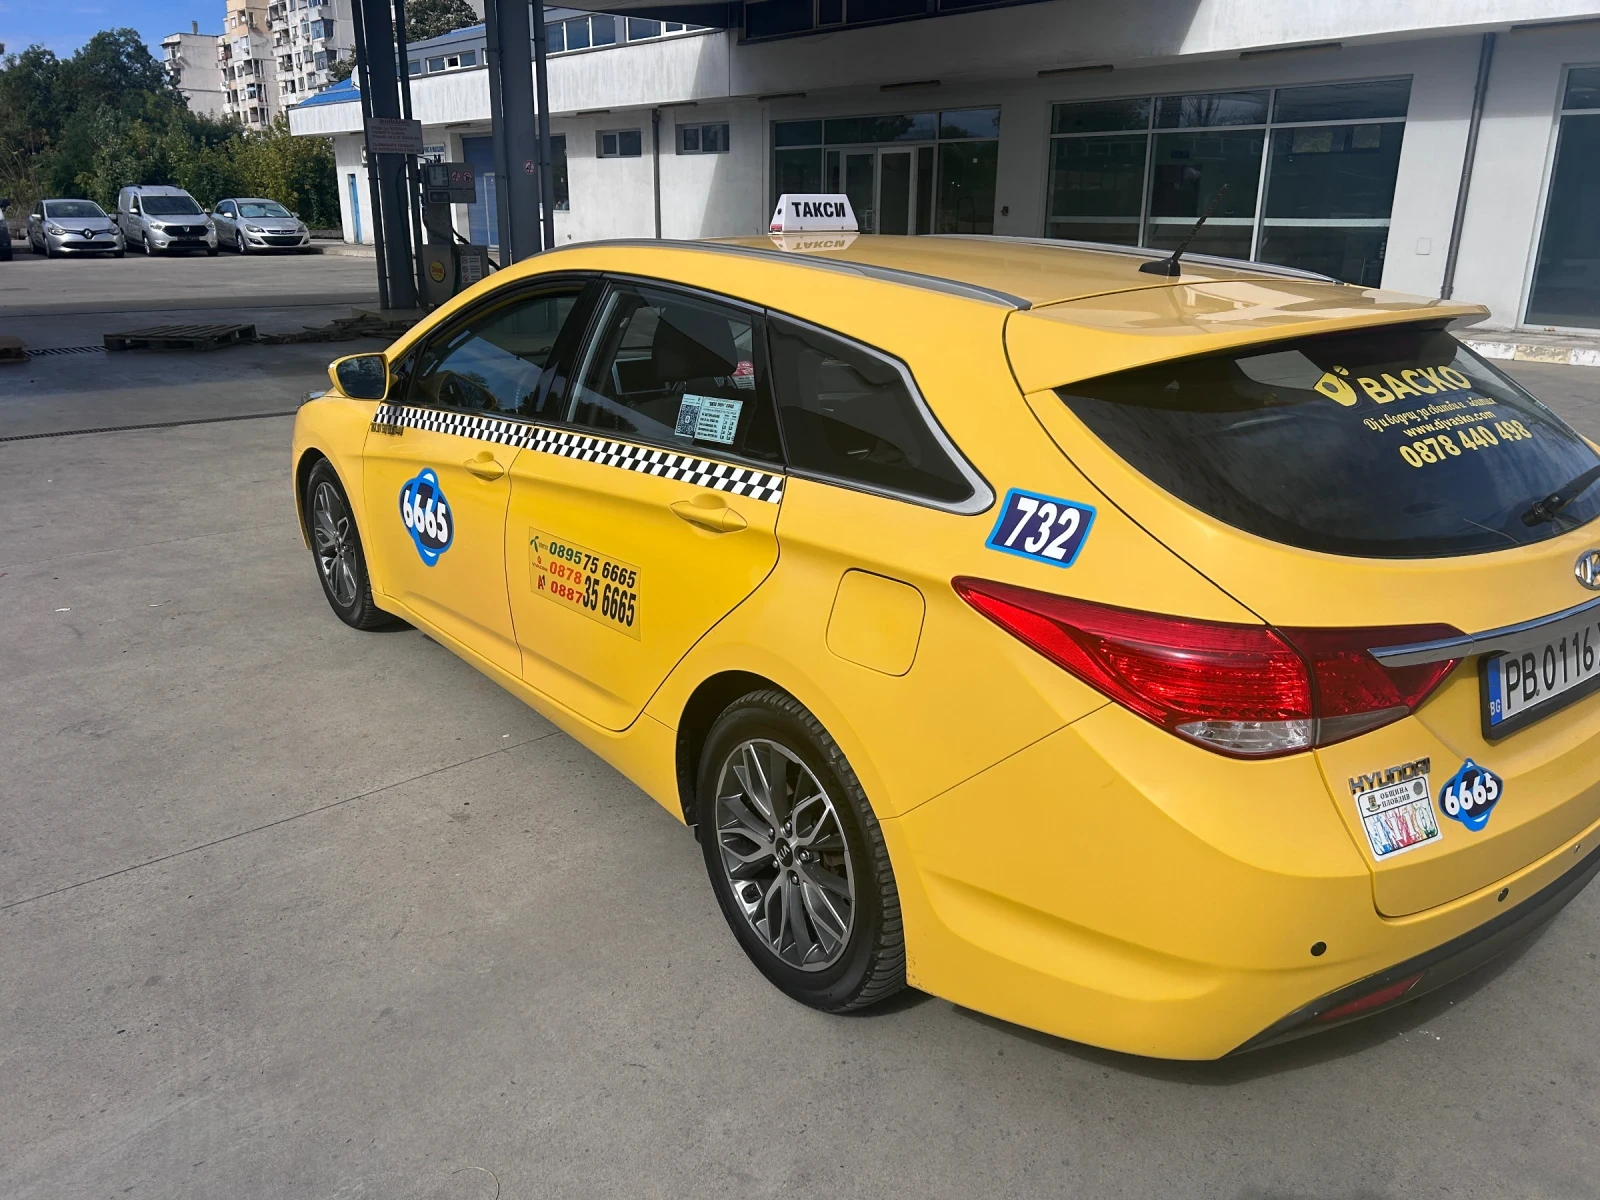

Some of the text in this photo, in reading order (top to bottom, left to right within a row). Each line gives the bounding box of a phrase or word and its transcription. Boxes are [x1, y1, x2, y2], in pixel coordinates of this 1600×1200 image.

[791, 202, 846, 217] ТАКСИ
[1357, 366, 1472, 404] ВАСКО
[1402, 410, 1497, 437] www.djvasko.com
[1400, 419, 1533, 468] 0878 440 498
[402, 489, 449, 543] 6665
[1003, 496, 1080, 560] 732
[549, 541, 582, 565] 0895
[582, 553, 600, 575] 75
[601, 561, 637, 589] 6665
[549, 561, 582, 585] 0878
[550, 580, 583, 604] 0887
[582, 575, 637, 627] 35 6665
[1505, 622, 1600, 710] PB0116
[1490, 699, 1501, 716] BG
[1348, 757, 1431, 795] HYUNDAI
[1379, 786, 1409, 800] ОБЩИНА
[1444, 772, 1499, 816] 6665
[1381, 793, 1411, 807] ПЛОВДИВ
